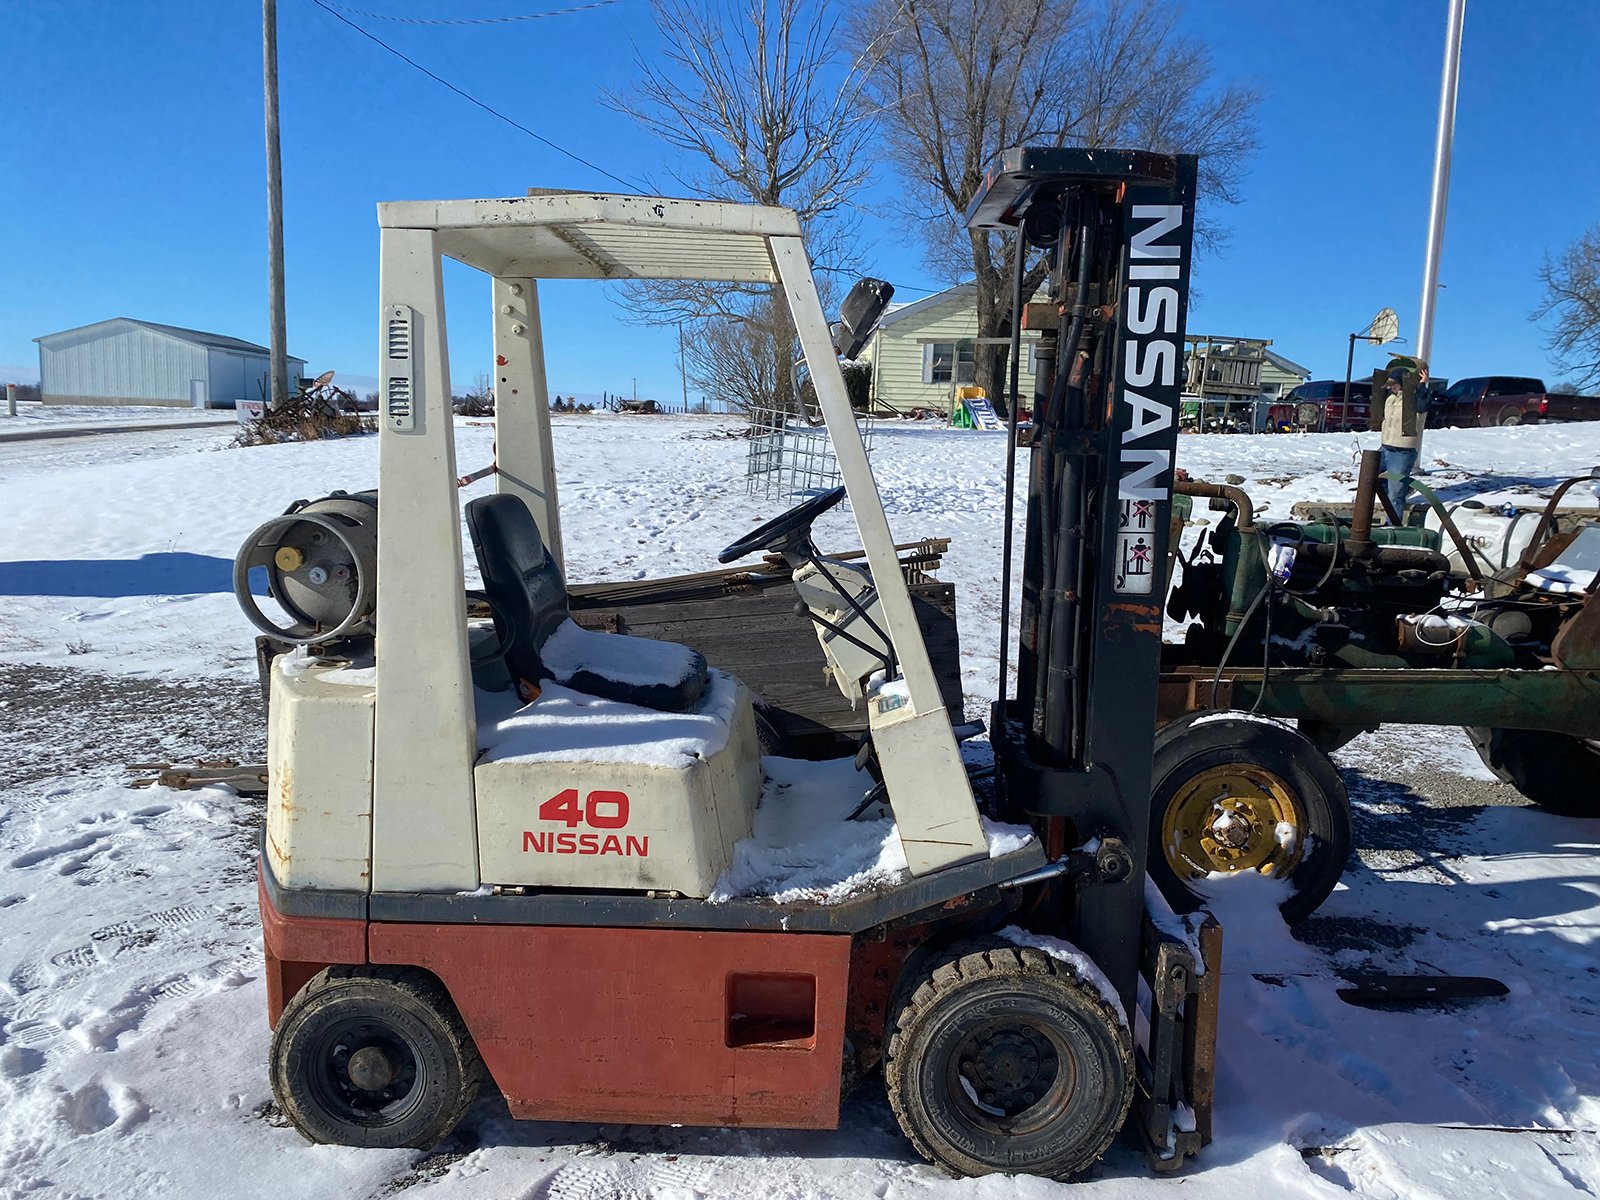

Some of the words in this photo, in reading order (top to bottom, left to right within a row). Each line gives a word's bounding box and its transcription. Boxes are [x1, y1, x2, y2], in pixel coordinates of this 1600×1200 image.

[1118, 204, 1183, 500] NISSAN
[539, 788, 629, 829] 40
[523, 831, 649, 857] NISSAN
